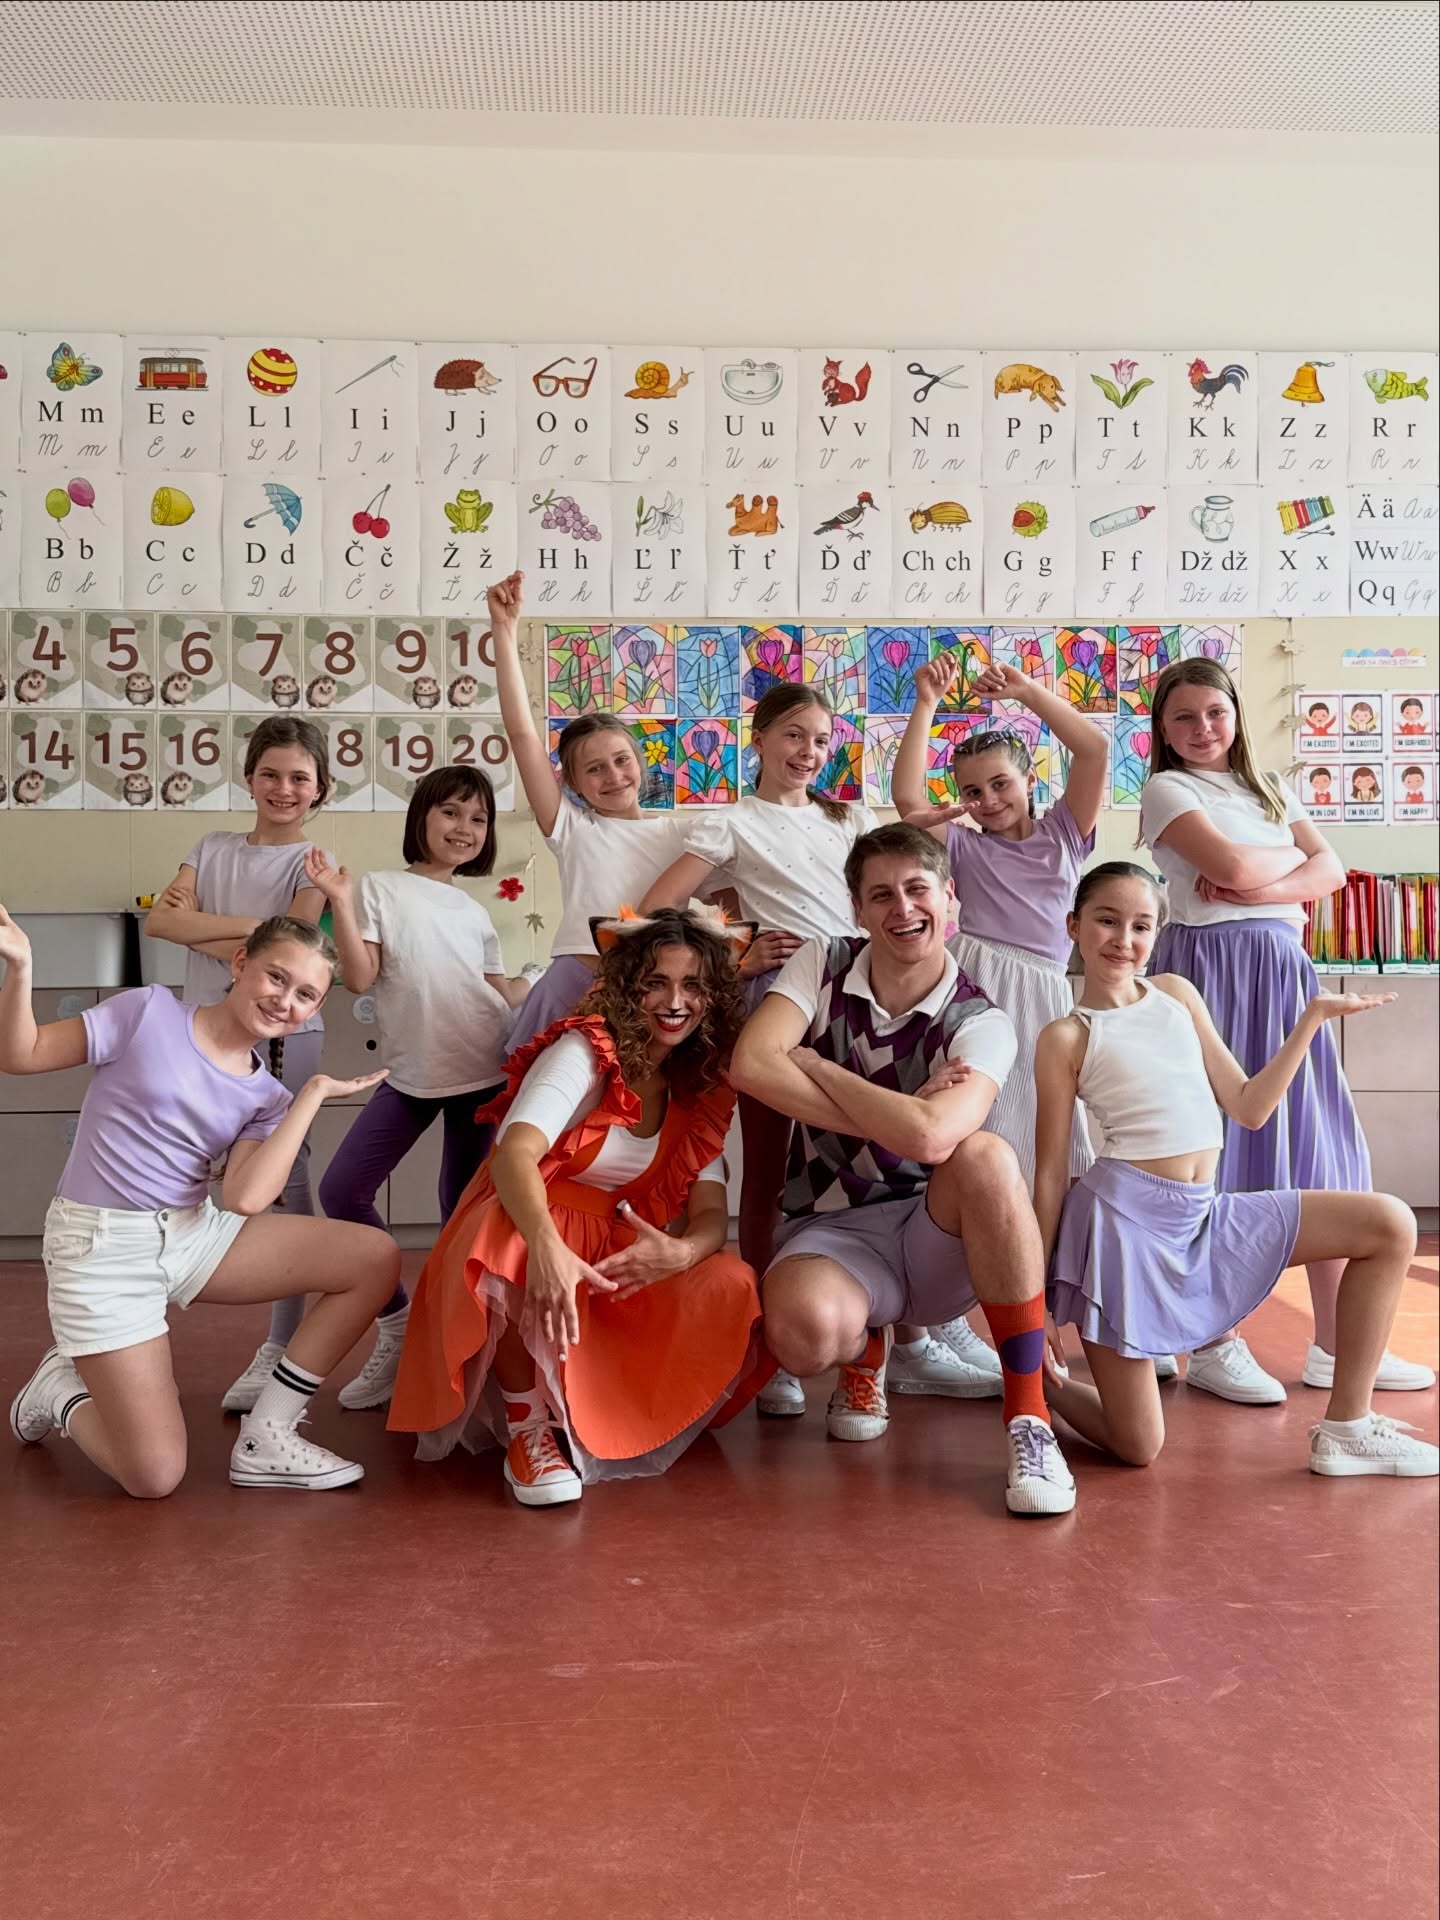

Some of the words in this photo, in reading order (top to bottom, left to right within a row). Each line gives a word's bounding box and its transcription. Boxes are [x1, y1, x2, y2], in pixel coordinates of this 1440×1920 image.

[38, 401, 62, 422] M
[81, 408, 103, 423] m
[149, 403, 165, 424] E
[182, 410, 194, 425] e
[249, 406, 265, 427] L
[285, 406, 290, 427] l
[352, 409, 358, 429] I
[382, 409, 388, 430] i
[537, 412, 556, 432] O
[575, 418, 588, 433] o
[446, 411, 455, 431] J
[476, 410, 484, 438] j
[635, 413, 649, 434] S
[669, 420, 678, 434] s
[725, 416, 743, 436] U
[762, 422, 774, 436] u
[819, 416, 837, 436] V
[853, 423, 866, 436] v
[910, 417, 930, 437] N
[947, 423, 960, 437] n
[1008, 418, 1020, 437] P
[1040, 424, 1052, 444] p
[1098, 418, 1114, 437] T
[1133, 420, 1139, 437] t
[1189, 417, 1207, 437] K
[1224, 417, 1235, 437] k
[1280, 418, 1296, 437] Z
[1315, 424, 1326, 437] z
[1373, 418, 1388, 437] R
[1408, 424, 1416, 437] r
[38, 434, 63, 455] M
[77, 445, 107, 456] m
[147, 436, 165, 458] E
[180, 447, 197, 458] e
[248, 439, 267, 460] L
[278, 440, 298, 461] l
[539, 444, 559, 465] O
[726, 447, 744, 468] U
[820, 448, 839, 469] V
[912, 448, 929, 470] N
[941, 459, 965, 470] n
[1006, 449, 1020, 470] P
[1035, 459, 1056, 480] p
[1187, 449, 1209, 470] K
[1219, 449, 1240, 469] k
[1371, 448, 1389, 469] R
[1402, 458, 1421, 469] r
[1358, 494, 1376, 518] Ä
[1383, 499, 1394, 518] ä
[46, 538, 64, 559] B
[79, 538, 93, 559] b
[146, 540, 164, 561] C
[183, 547, 195, 562] c
[246, 543, 266, 563] D
[281, 543, 294, 564] d
[345, 540, 363, 566] Č
[381, 547, 392, 567] č
[443, 542, 460, 568] Ž
[480, 548, 492, 568] ž
[539, 549, 557, 568] H
[575, 548, 588, 569] h
[636, 549, 651, 569] Ľ
[671, 549, 681, 569] ľ
[729, 544, 745, 569] Ť
[764, 549, 776, 570] ť
[821, 545, 839, 570] Ď
[853, 550, 871, 570] ď
[903, 550, 934, 571] Ch
[946, 550, 970, 571] ch
[1004, 551, 1022, 571] G
[1039, 557, 1052, 577] g
[1102, 551, 1115, 570] F
[1132, 551, 1142, 570] f
[1181, 551, 1212, 570] Dž
[1222, 550, 1247, 570] dž
[1280, 550, 1296, 570] X
[1316, 556, 1328, 570] x
[47, 571, 62, 592] B
[75, 571, 96, 593] b
[147, 573, 164, 595] C
[248, 575, 264, 597] D
[279, 576, 296, 597] d
[346, 573, 365, 599] Č
[379, 584, 395, 600] č
[538, 580, 559, 601] H
[570, 581, 592, 602] h
[633, 577, 653, 602] Ľ
[664, 581, 687, 602] ľ
[821, 578, 840, 602] Ď
[851, 582, 870, 603] ď
[905, 582, 932, 603] Ch
[945, 582, 970, 603] ch
[1179, 582, 1212, 603] Dž
[1219, 583, 1248, 603] dž
[1277, 581, 1299, 602] X
[1359, 580, 1377, 604] Q
[1383, 586, 1394, 606] q
[1005, 582, 1023, 612] G
[1036, 592, 1052, 613] g
[1127, 582, 1144, 613] f
[32, 626, 66, 670] 4
[106, 628, 139, 671] 5
[181, 632, 213, 676] 6
[256, 633, 284, 676] 7
[325, 631, 355, 675] 8
[395, 630, 427, 673] 9
[21, 731, 75, 770] 14
[94, 732, 148, 770] 15
[169, 728, 220, 765] 16
[386, 735, 434, 773] 19
[452, 734, 509, 765] 20
